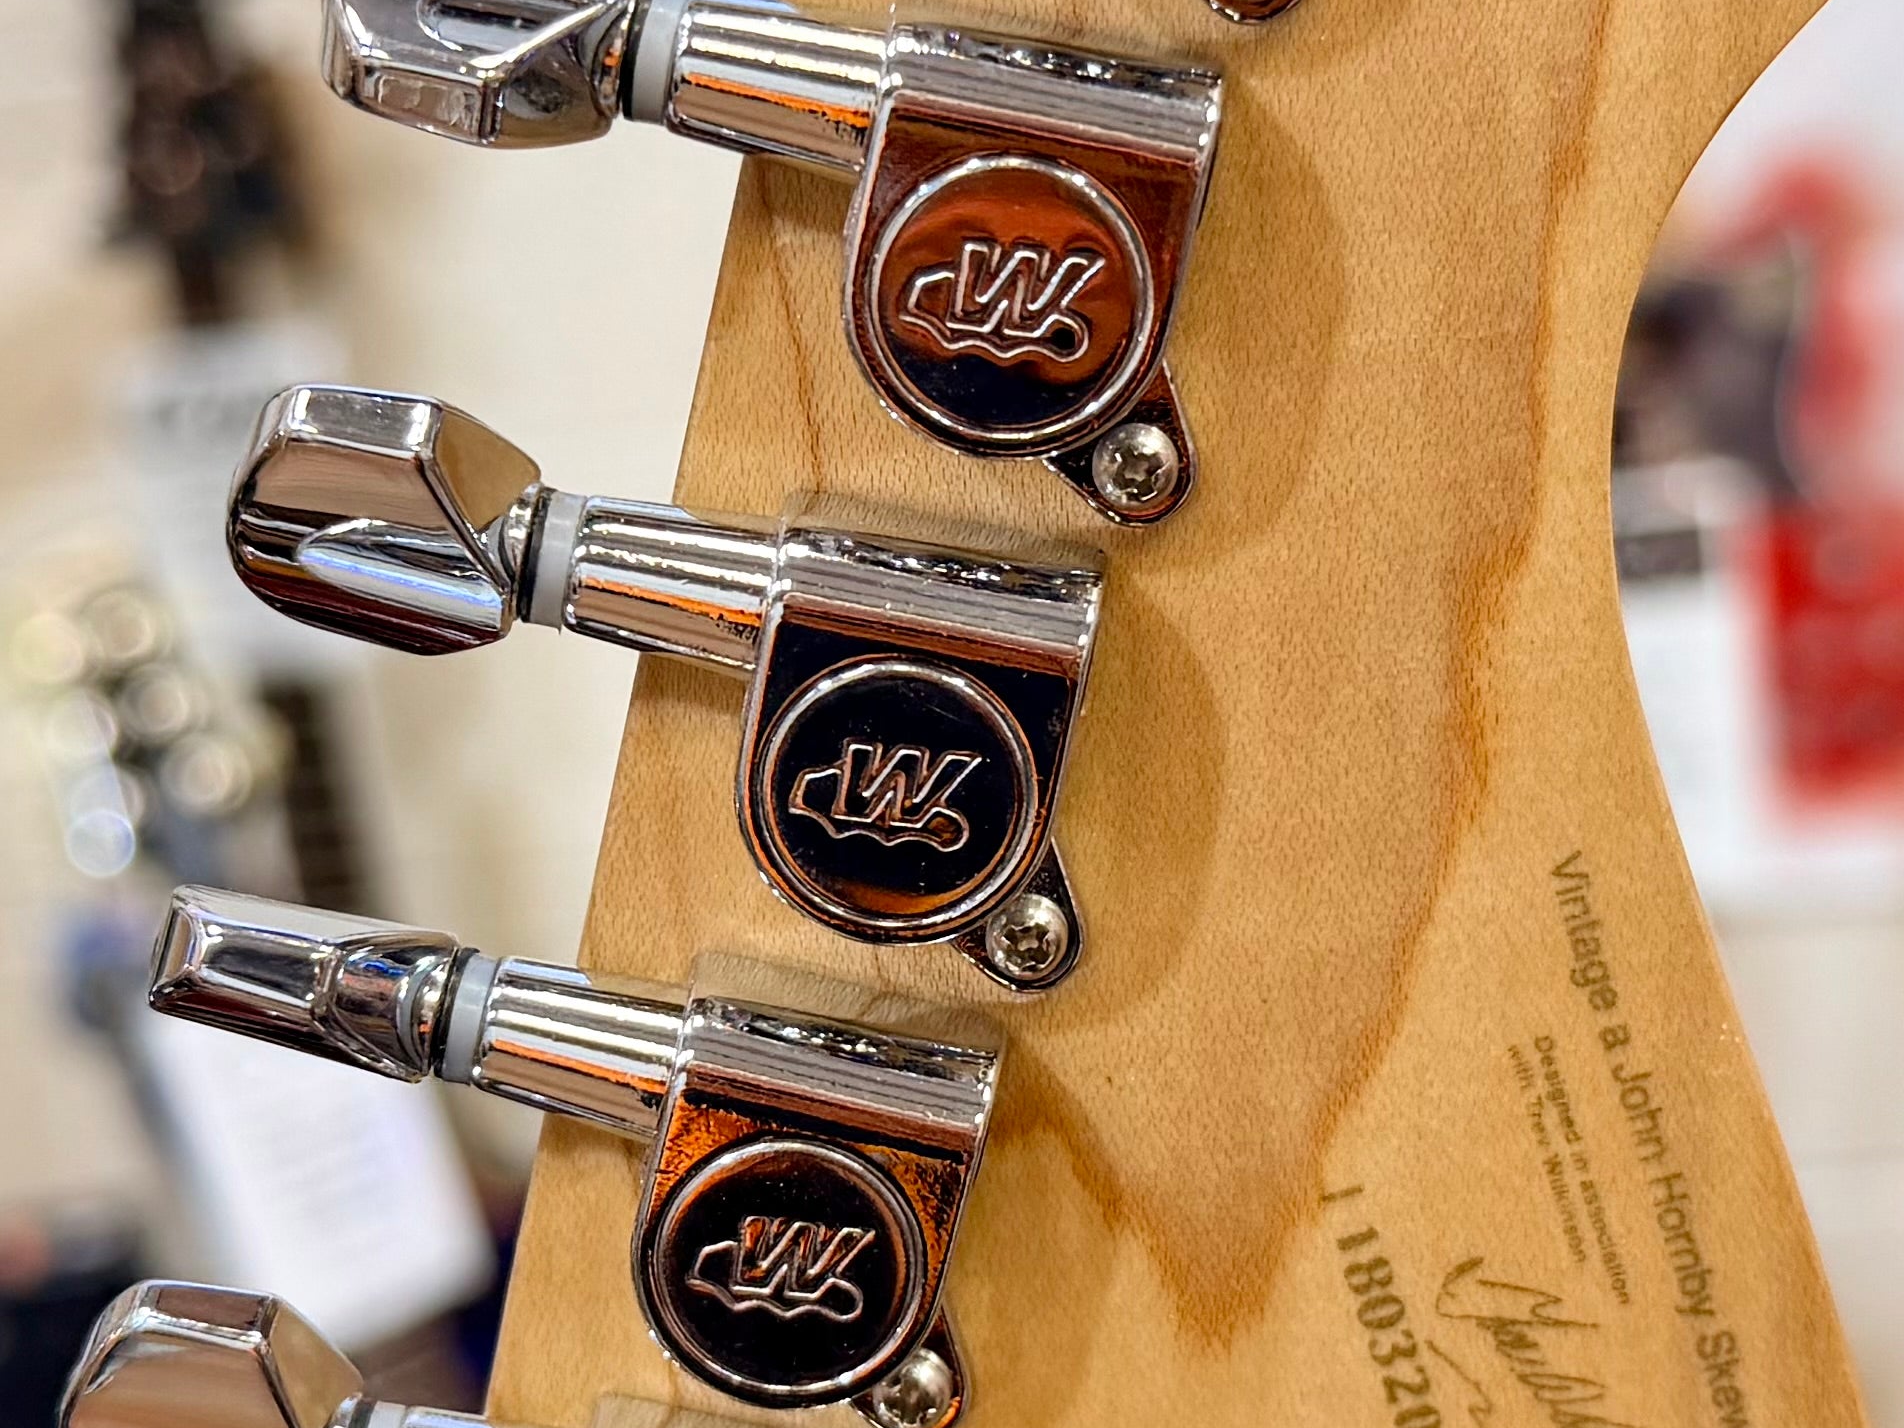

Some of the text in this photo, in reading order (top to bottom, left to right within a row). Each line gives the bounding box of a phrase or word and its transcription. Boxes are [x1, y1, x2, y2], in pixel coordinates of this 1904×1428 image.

[1550, 849, 1618, 1012] Vintage
[1599, 1023, 1631, 1052] a
[1610, 1063, 1667, 1162] John
[1507, 1044, 1534, 1090] with
[1542, 1152, 1586, 1263] Wilkinson
[1534, 1035, 1630, 1305] Designed in association
[1648, 1171, 1715, 1318] Hornby
